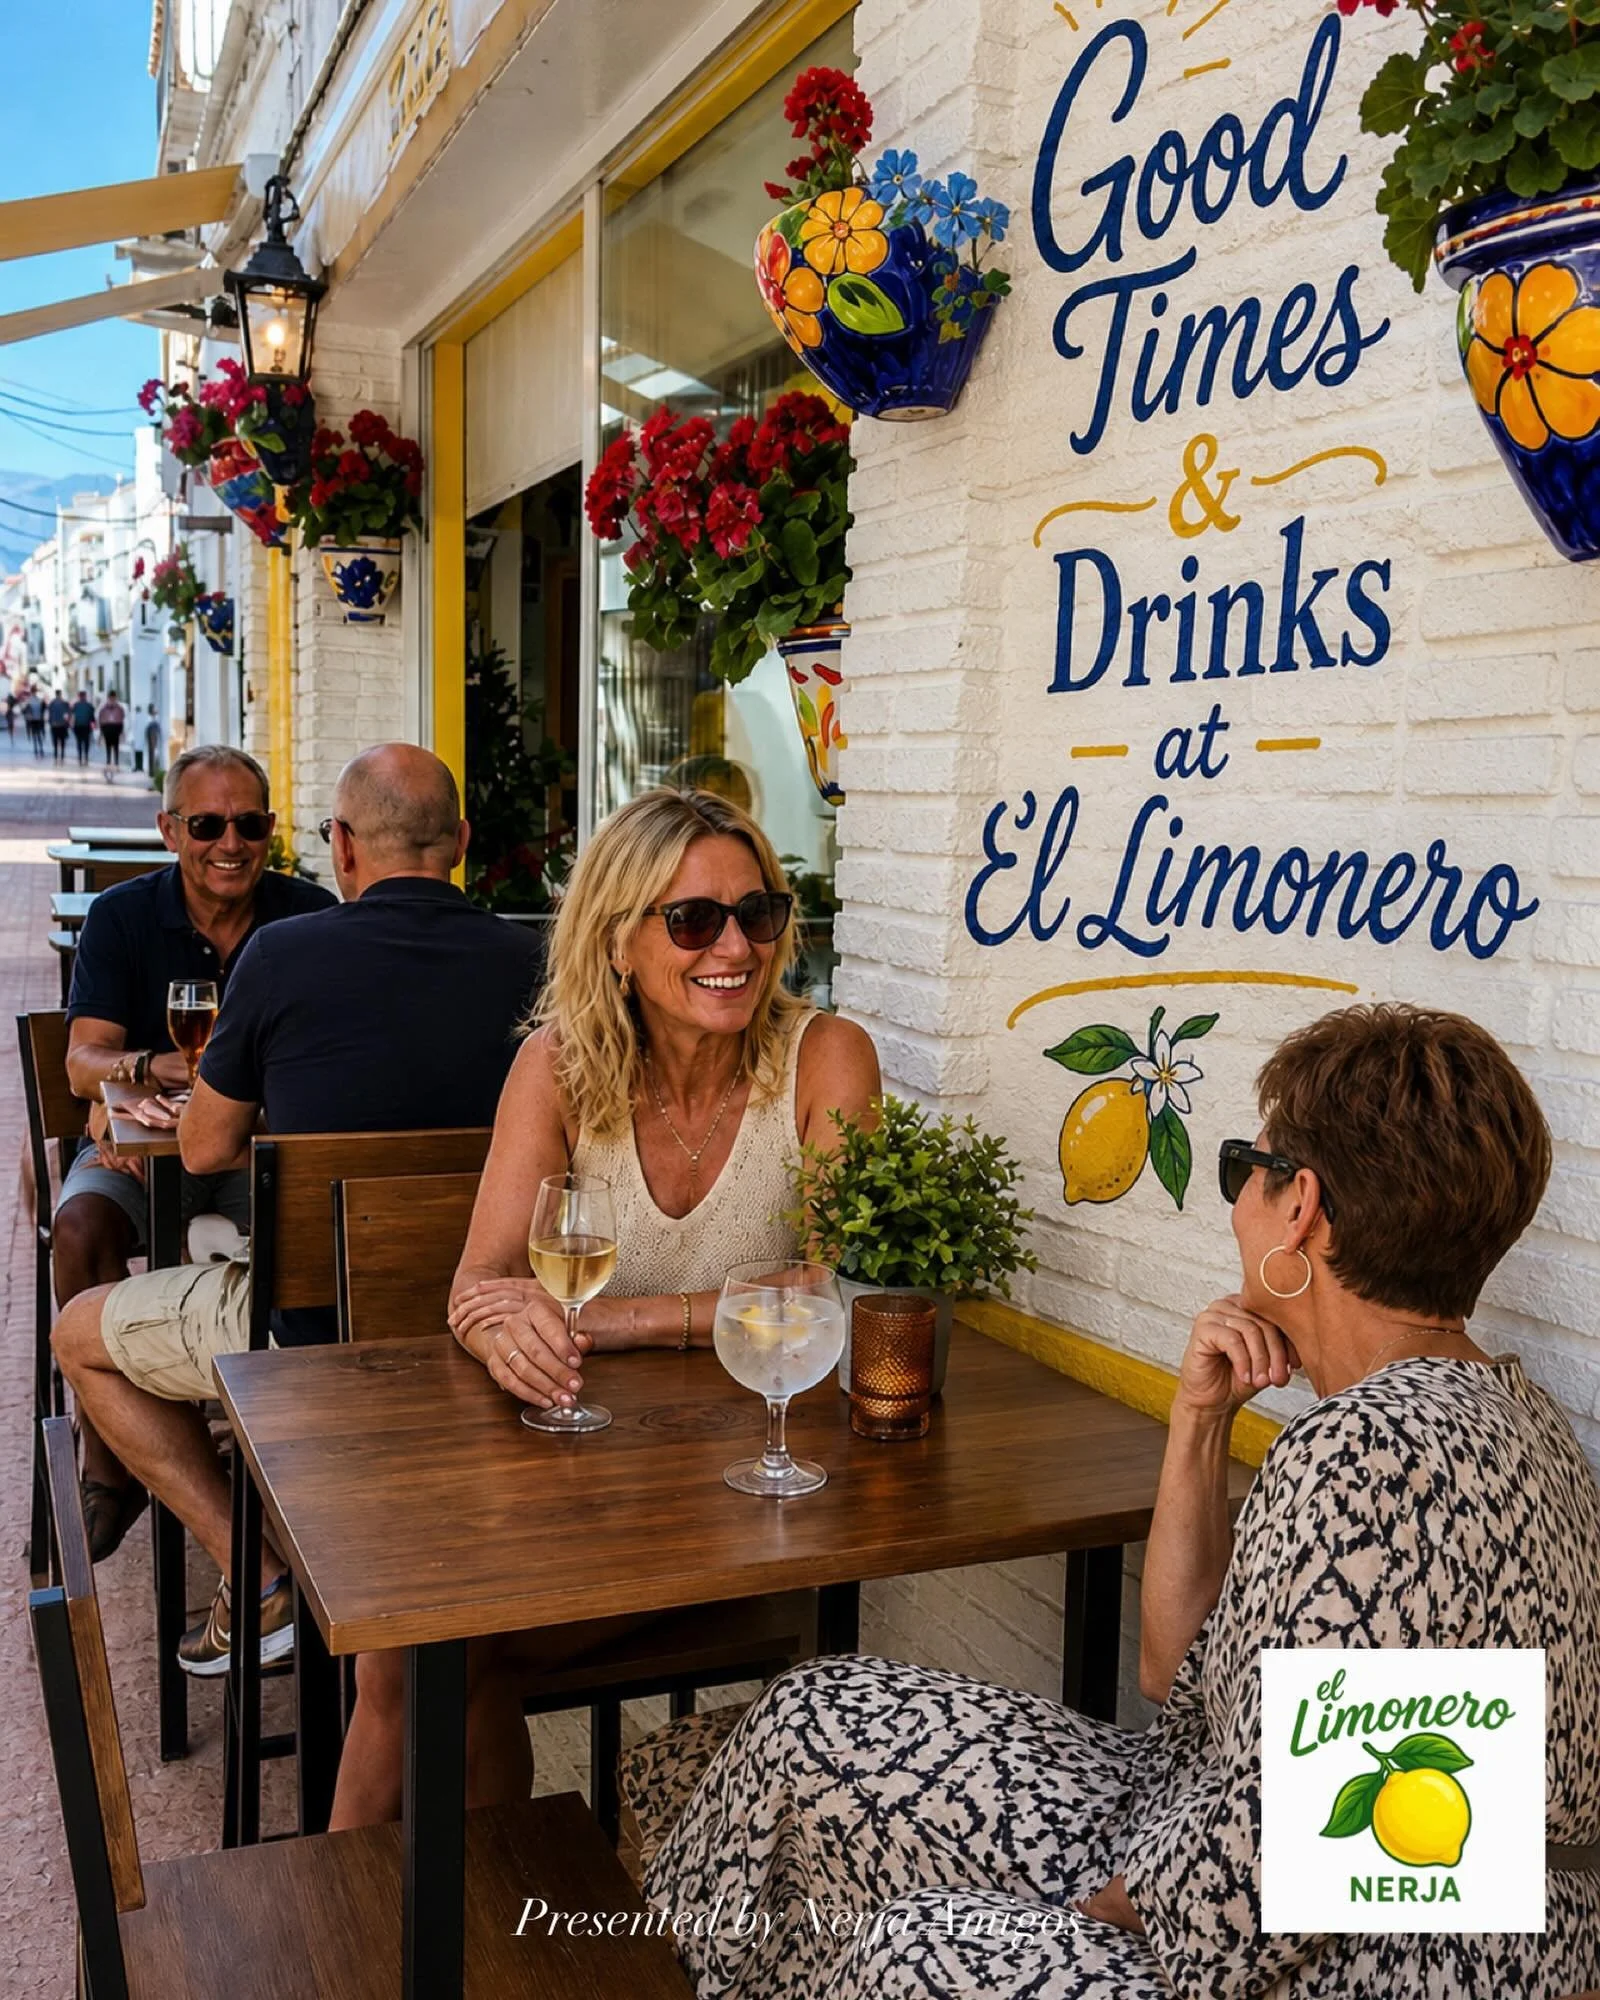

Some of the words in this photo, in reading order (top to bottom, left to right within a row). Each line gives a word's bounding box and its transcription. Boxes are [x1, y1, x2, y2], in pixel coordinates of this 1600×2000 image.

[1032, 12, 1348, 273] Good
[1052, 246, 1391, 455] Times
[1168, 433, 1241, 539] &
[1047, 516, 1392, 694] Drinks
[1154, 703, 1230, 779] at
[964, 786, 1080, 946] El
[1077, 795, 1540, 960] Limonero
